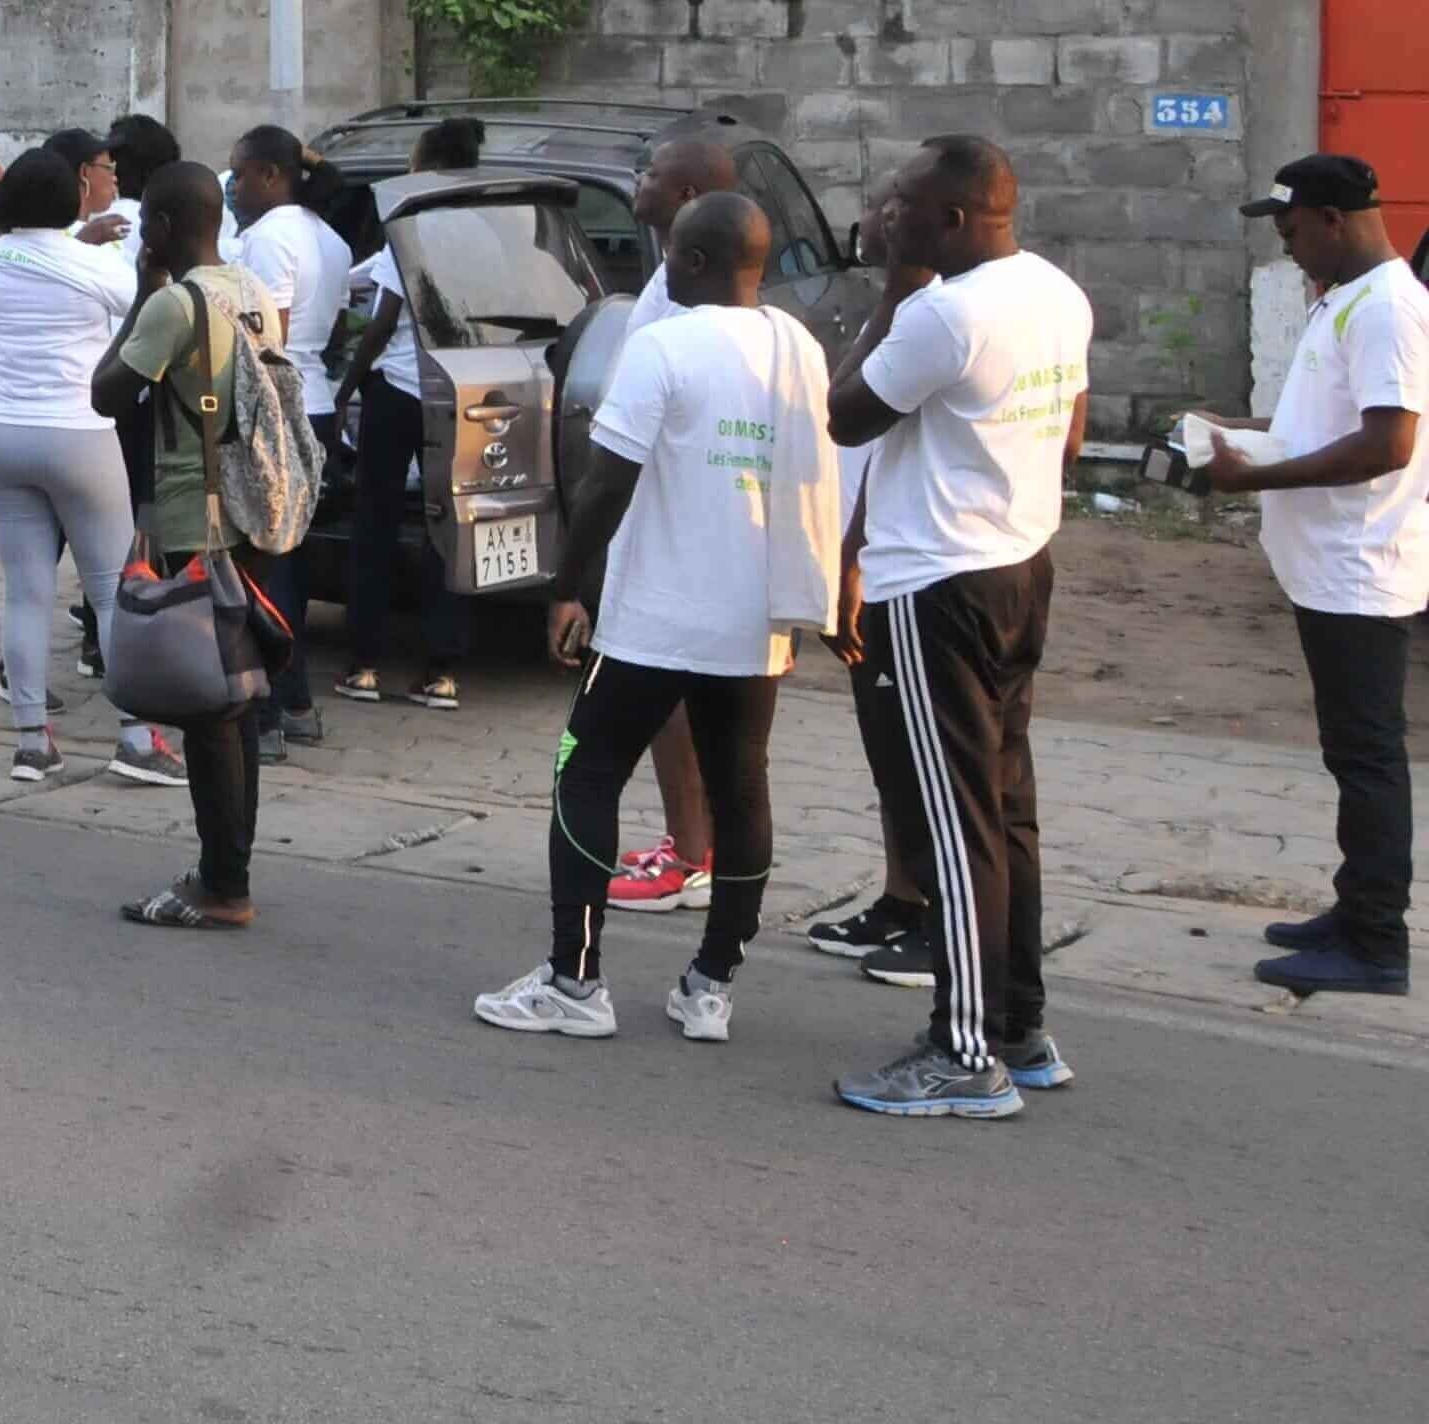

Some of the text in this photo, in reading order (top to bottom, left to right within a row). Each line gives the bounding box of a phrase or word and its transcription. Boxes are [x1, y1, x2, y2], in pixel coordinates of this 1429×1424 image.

[1156, 98, 1223, 125] 354
[486, 525, 506, 551] AX
[482, 548, 529, 581] 7155
